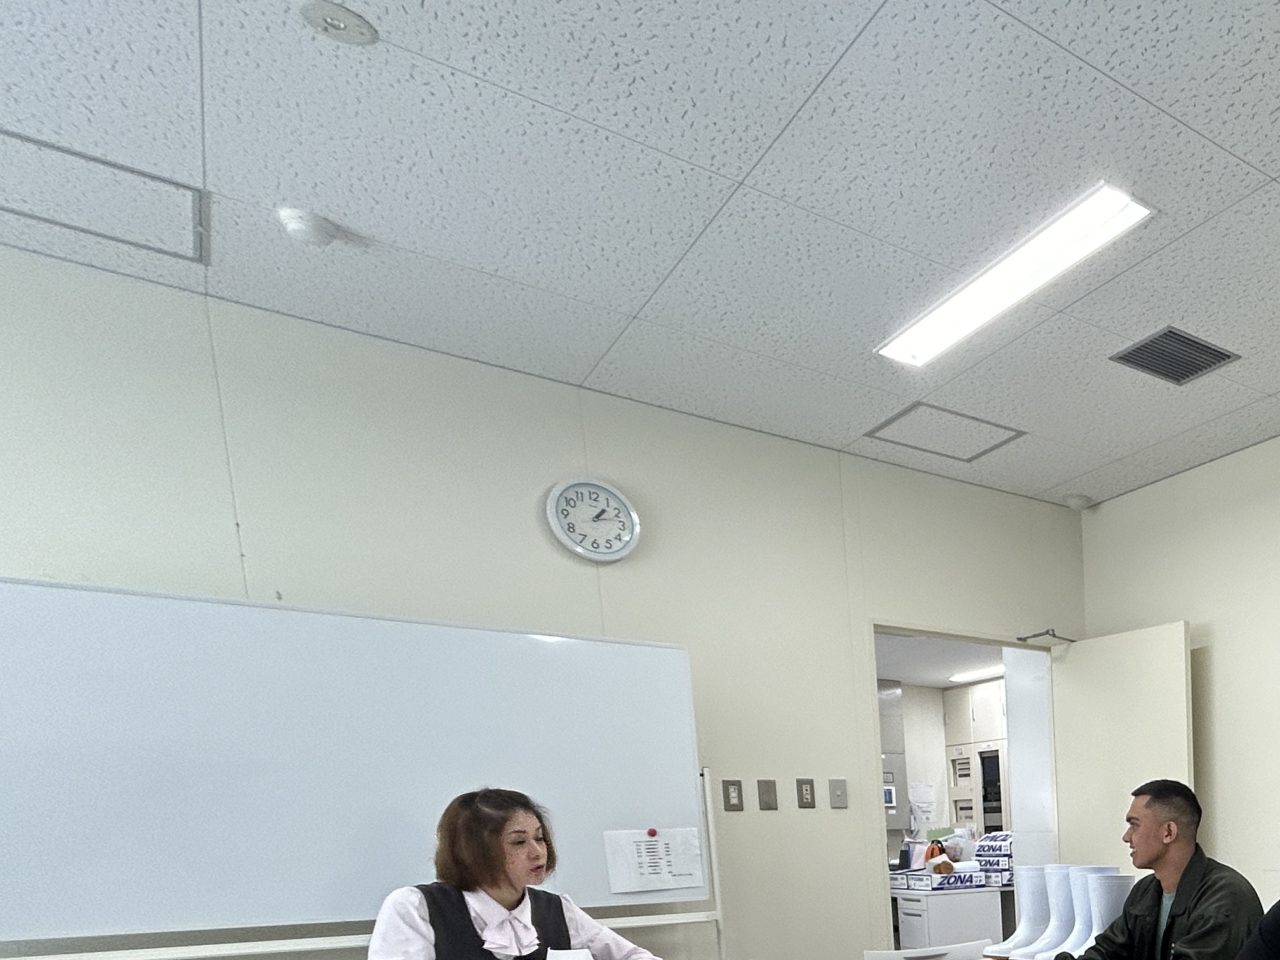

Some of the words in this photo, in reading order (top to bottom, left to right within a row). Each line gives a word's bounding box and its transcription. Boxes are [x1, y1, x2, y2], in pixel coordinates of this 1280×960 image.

[575, 490, 584, 502] 11
[588, 490, 600, 502] 12
[564, 496, 577, 508] 10
[605, 497, 610, 508] 1
[561, 508, 570, 519] 9
[613, 507, 622, 518] 2
[567, 522, 576, 534] 8
[618, 520, 626, 532] 3
[578, 533, 587, 544] 7
[591, 538, 600, 549] 6
[604, 538, 613, 549] 5
[614, 533, 622, 543] 4
[976, 844, 1002, 852] ZONA
[938, 874, 974, 886] ZONA
